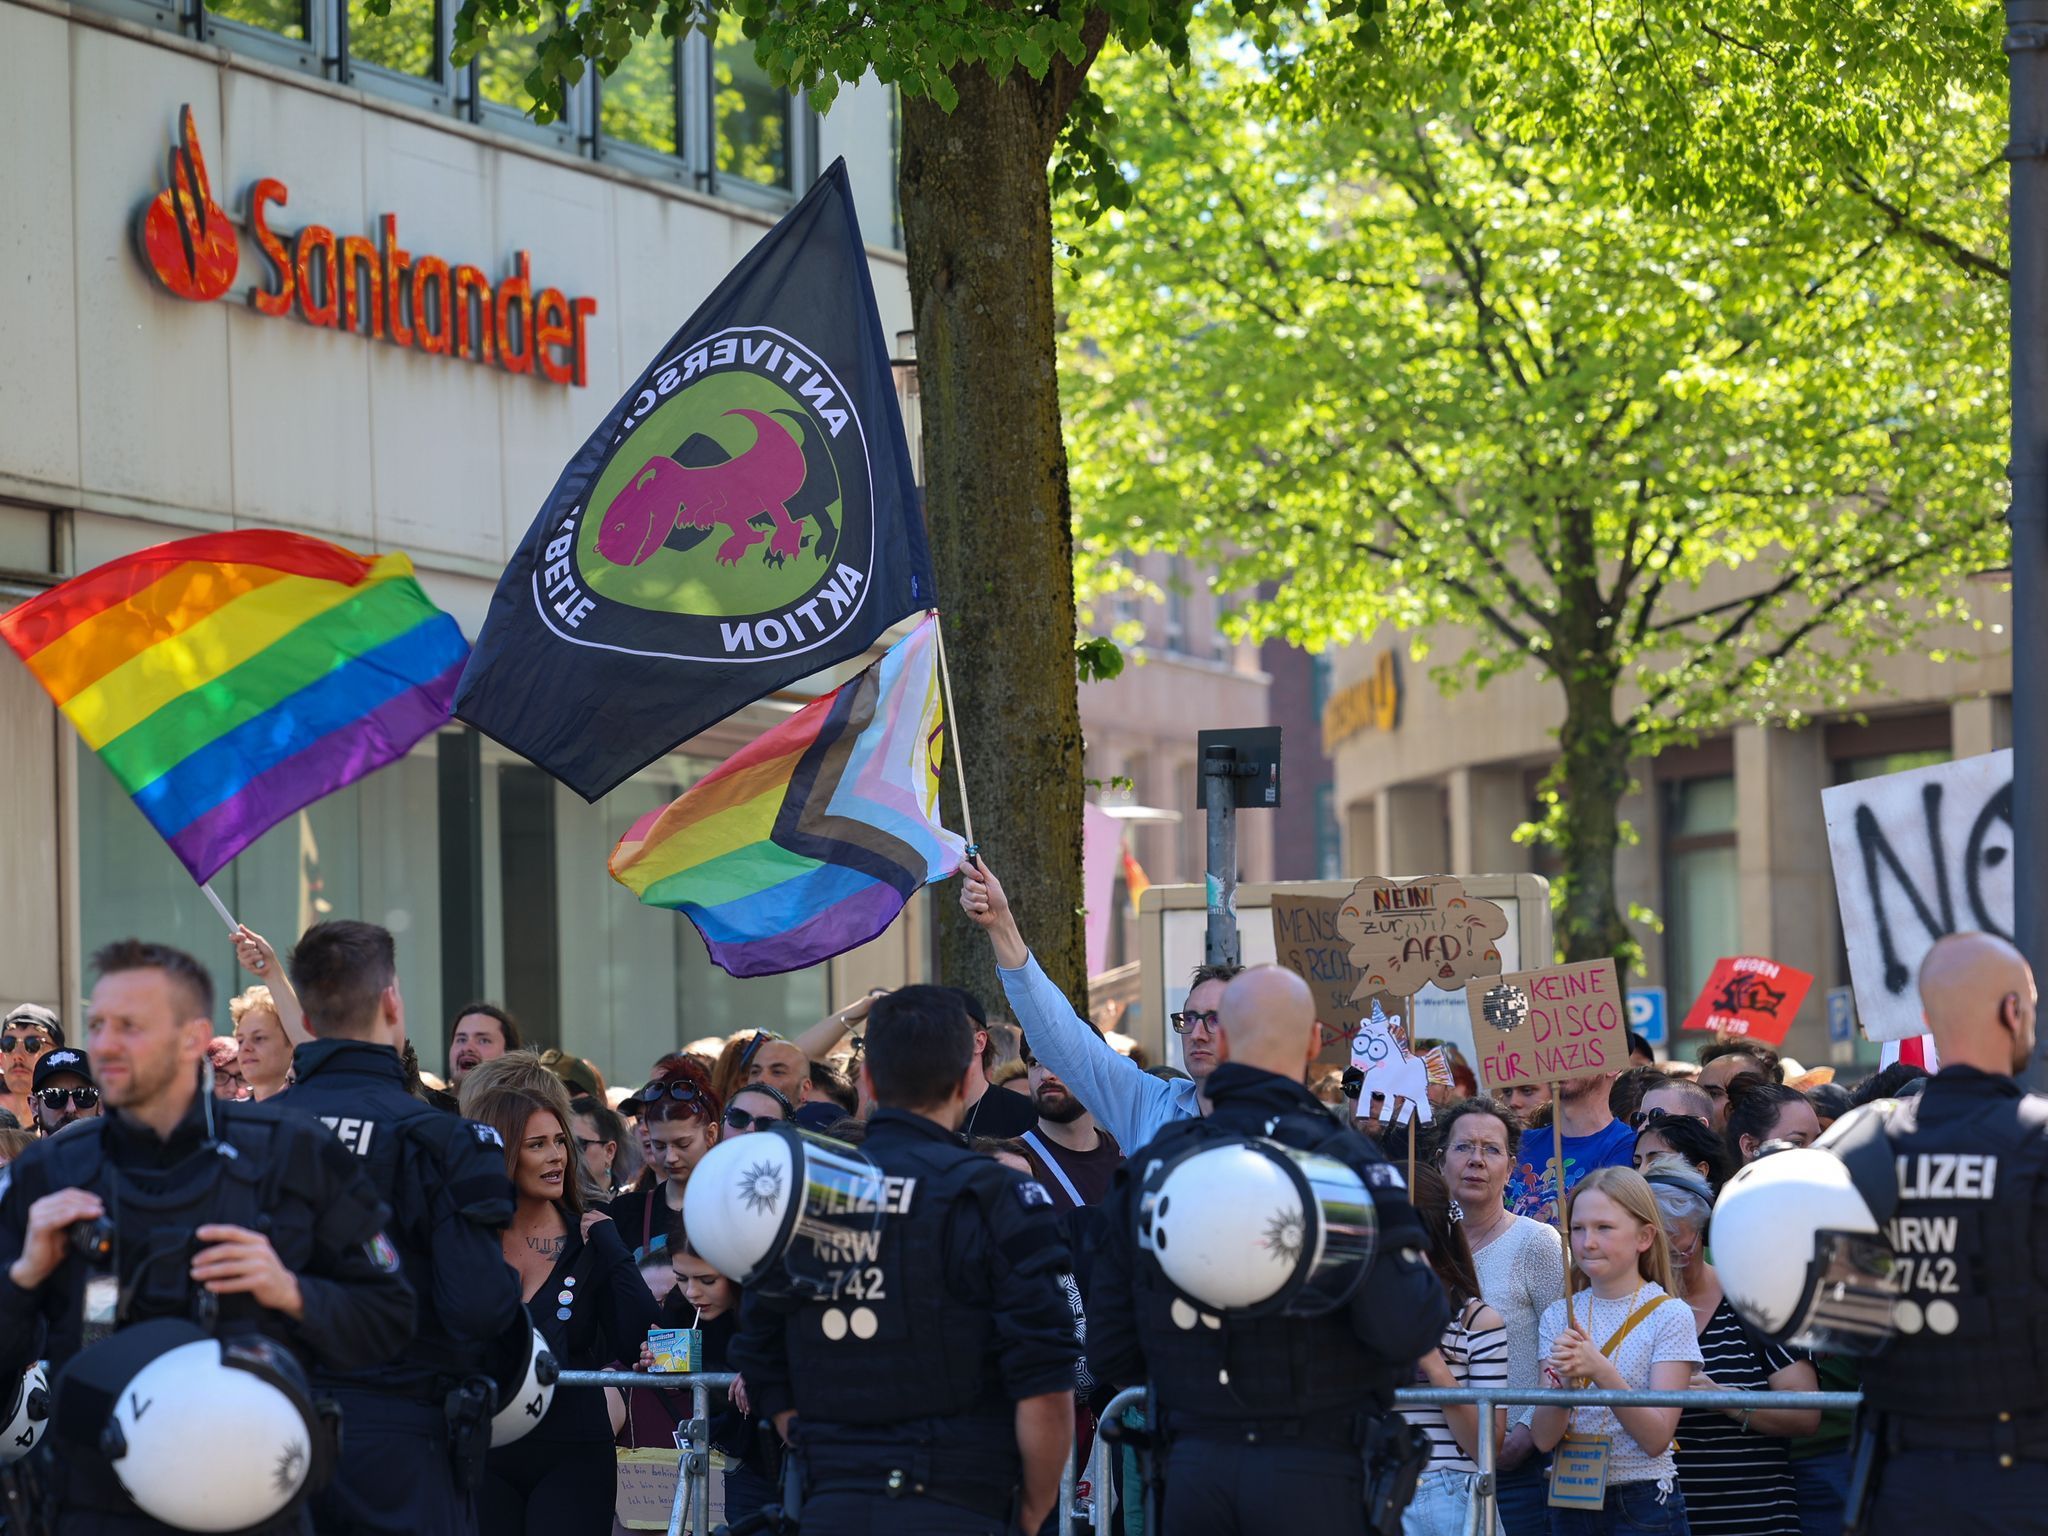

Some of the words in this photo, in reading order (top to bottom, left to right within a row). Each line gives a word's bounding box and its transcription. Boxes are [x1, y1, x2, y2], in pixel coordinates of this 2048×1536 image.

[250, 178, 596, 388] Santander
[1530, 969, 1605, 1002] KEINE
[1530, 1001, 1617, 1043] DISCO
[1484, 1040, 1530, 1085] FÜR
[1534, 1038, 1605, 1076] NAZIS
[1896, 1154, 1998, 1199] LIZEI
[813, 1267, 886, 1300] 742
